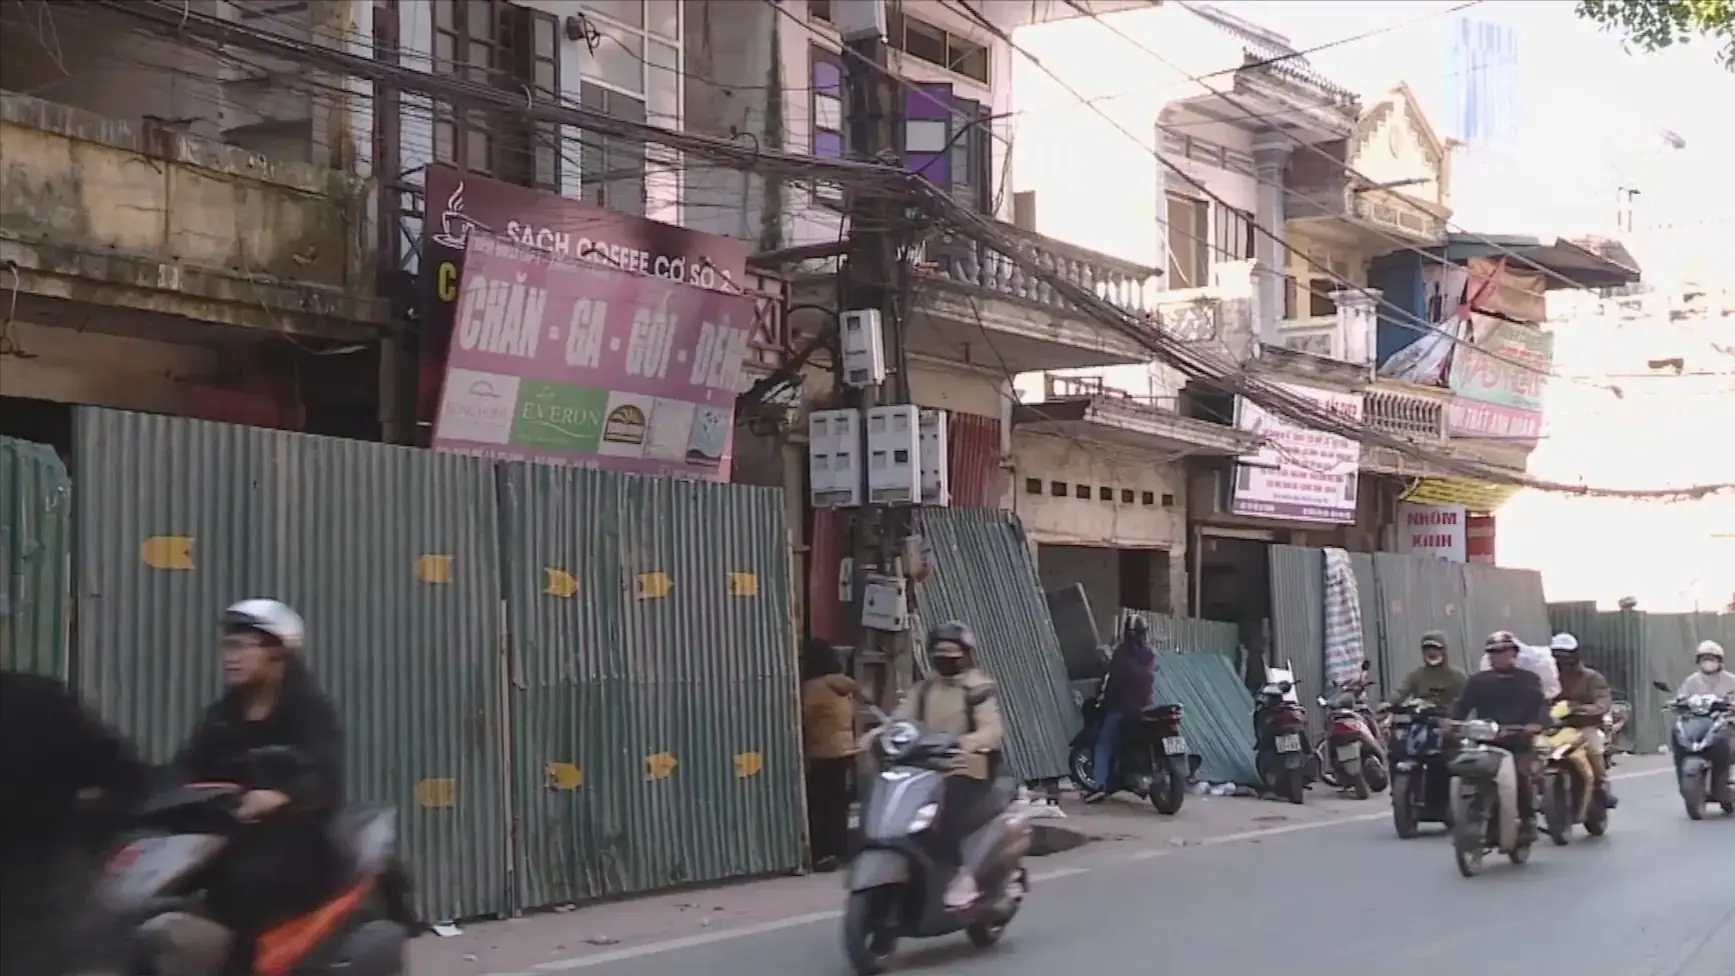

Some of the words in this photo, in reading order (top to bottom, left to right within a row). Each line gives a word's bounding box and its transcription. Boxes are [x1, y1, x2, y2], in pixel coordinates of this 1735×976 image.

[577, 237, 649, 275] COFFEE
[459, 272, 547, 358] CHĂN
[565, 299, 608, 368] GA
[626, 291, 678, 379] GỐI
[521, 402, 600, 428] EVERON
